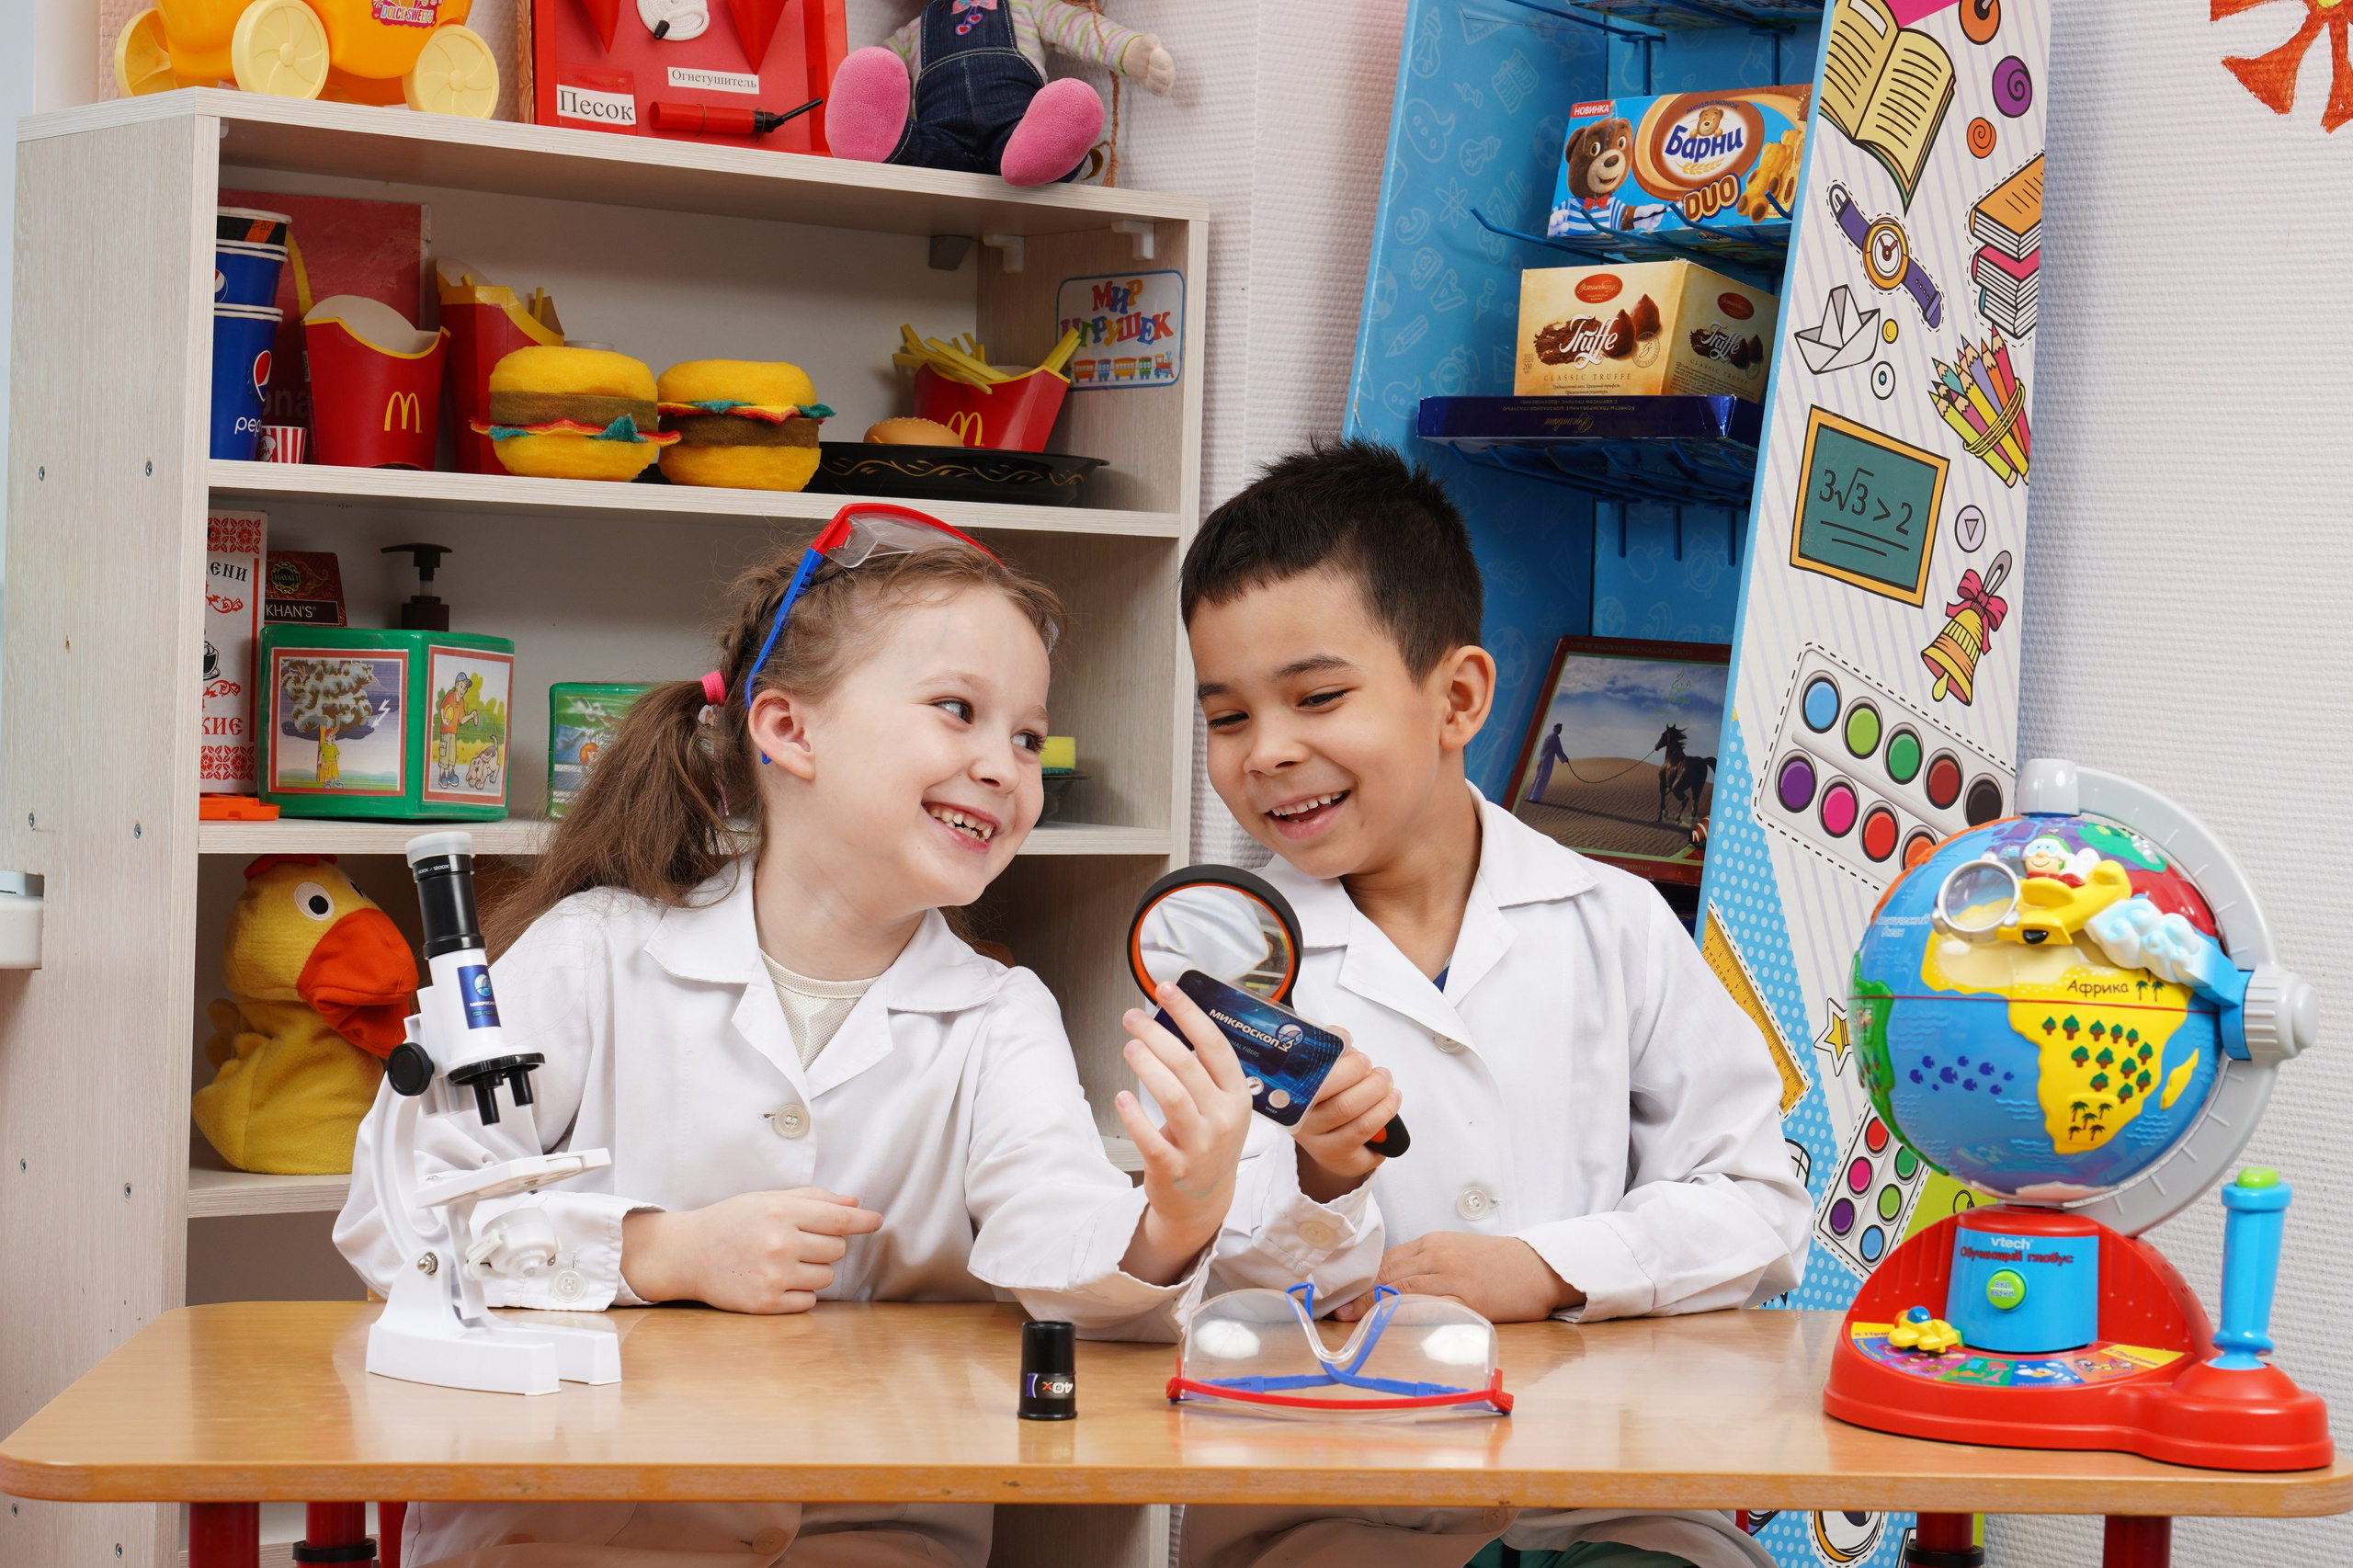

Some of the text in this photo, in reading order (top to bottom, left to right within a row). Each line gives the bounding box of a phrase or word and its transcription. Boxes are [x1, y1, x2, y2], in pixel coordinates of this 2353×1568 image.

[405, 8, 434, 23] SWEETS
[671, 70, 756, 88] Огнетушитель
[559, 89, 634, 121] Песок
[1574, 104, 1609, 116] НОВИНКА
[1665, 124, 1744, 164] Барни
[1683, 175, 1739, 222] DUO
[1092, 278, 1143, 314] МИР
[1559, 313, 1619, 369] Truffe
[1700, 320, 1741, 361] Truffe
[1543, 373, 1586, 381] CLASSIC
[273, 574, 300, 582] HAYATI
[265, 604, 313, 619] KHAN'S
[2066, 979, 2130, 998] Африка
[1209, 1008, 1281, 1048] МИКРОСКОП
[1243, 1046, 1260, 1058] FIBERS
[1990, 1236, 2030, 1250] vtech
[1960, 1245, 2074, 1267] Обучающий глобус
